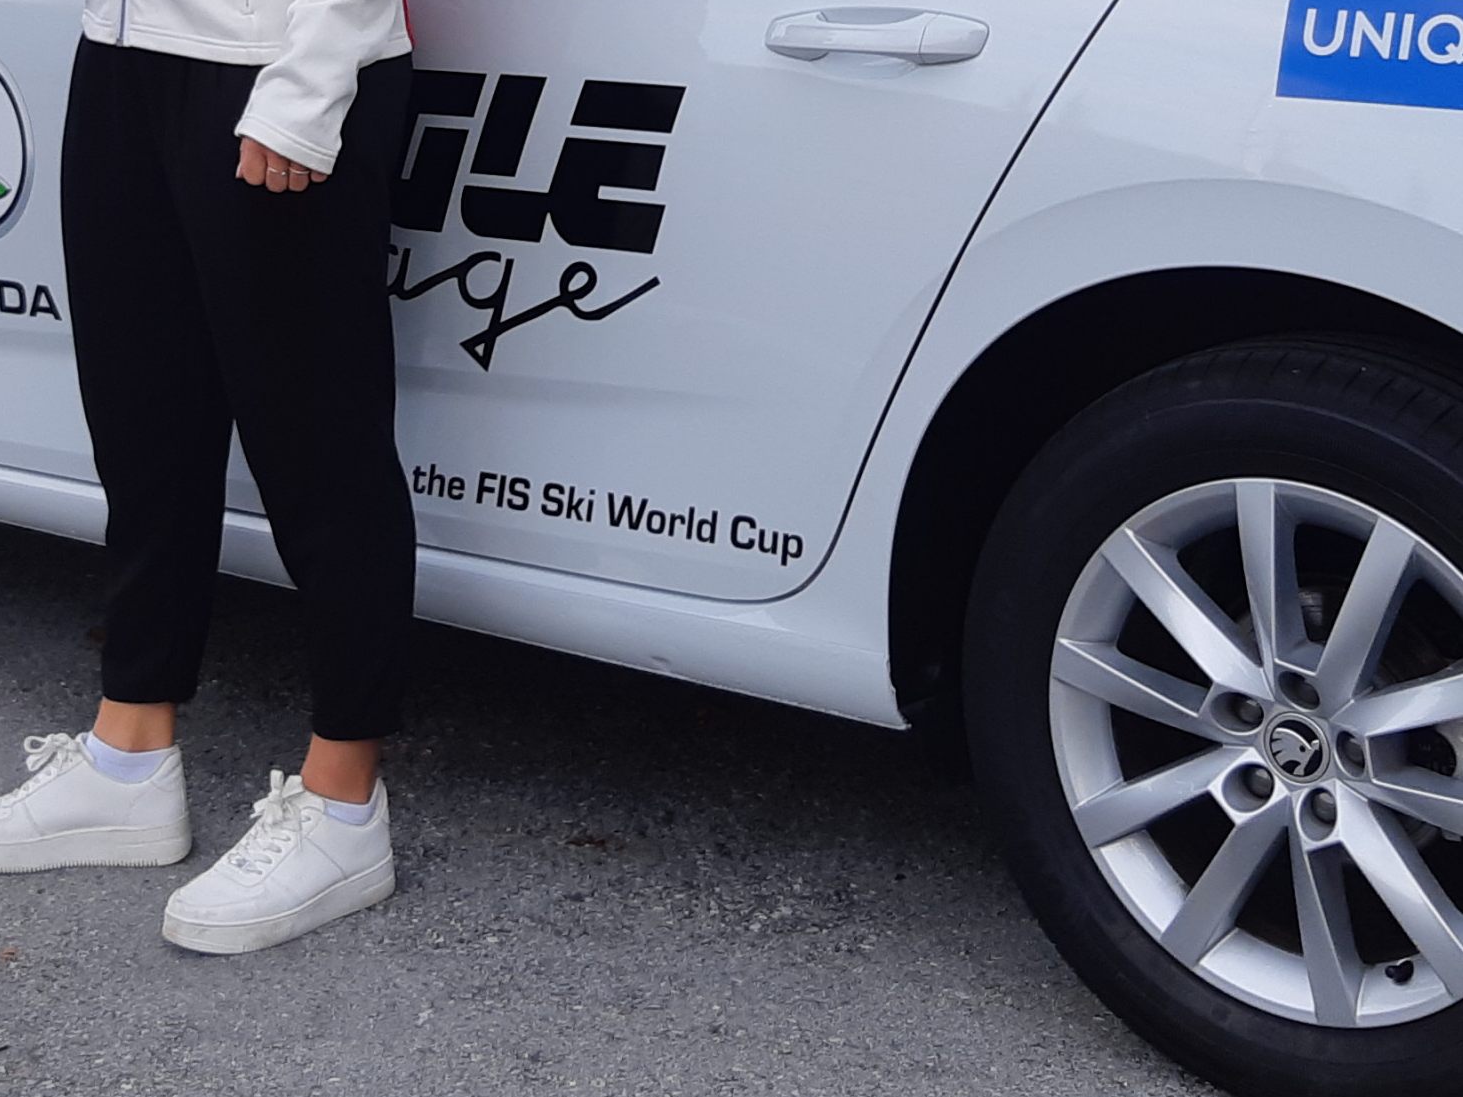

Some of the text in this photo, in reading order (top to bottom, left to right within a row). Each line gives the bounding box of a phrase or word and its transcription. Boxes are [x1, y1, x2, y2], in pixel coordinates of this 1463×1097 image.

[1303, 8, 1463, 64] UNIQ
[391, 69, 687, 255] GLE
[412, 463, 803, 567] the FIS Ski World Cup
